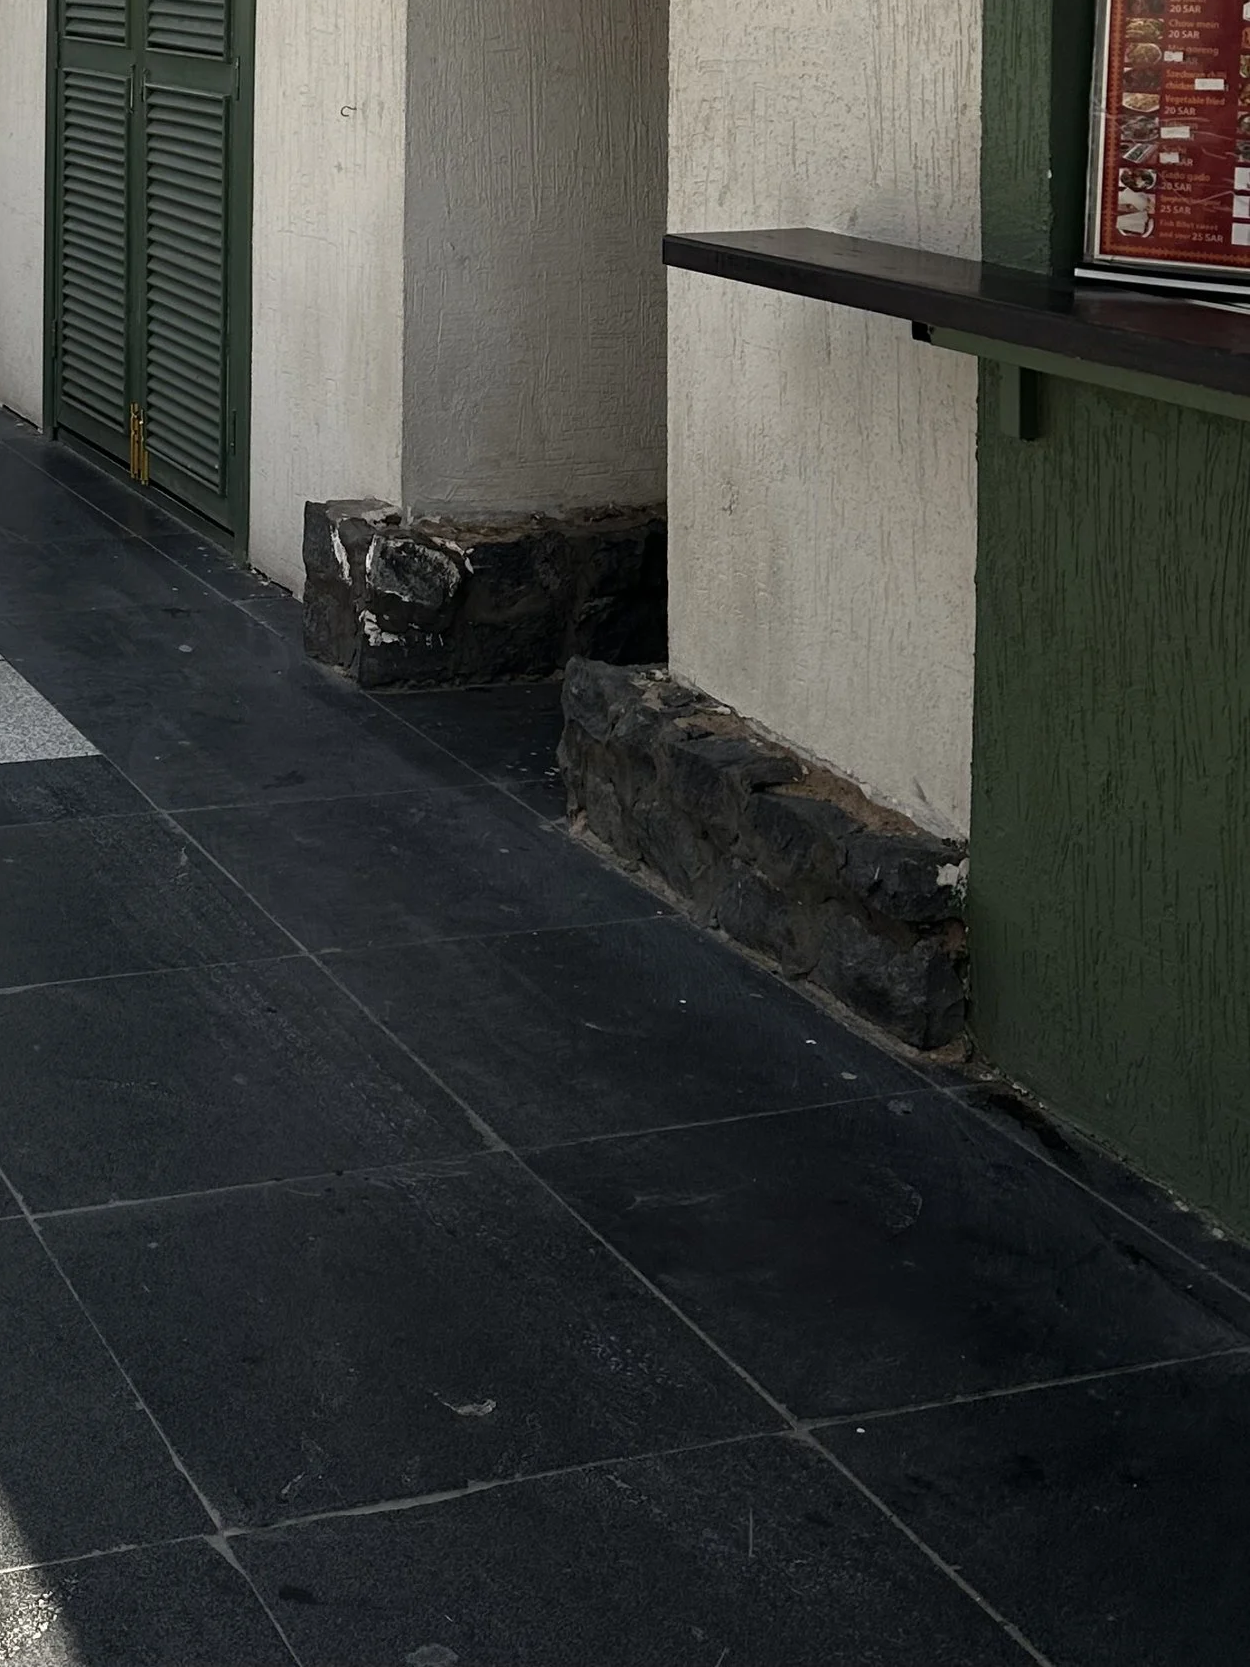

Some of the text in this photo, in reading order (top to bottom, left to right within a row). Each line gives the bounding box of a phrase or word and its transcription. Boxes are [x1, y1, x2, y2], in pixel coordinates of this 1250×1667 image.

[1170, 4, 1202, 14] 20 SAR
[1168, 30, 1200, 39] 20 SAR
[1164, 107, 1196, 116] 20 SAR
[1161, 182, 1192, 192] 20 SAR
[1160, 205, 1192, 215] 25 SAR
[1191, 232, 1204, 242] 25
[1205, 233, 1224, 244] SAR
